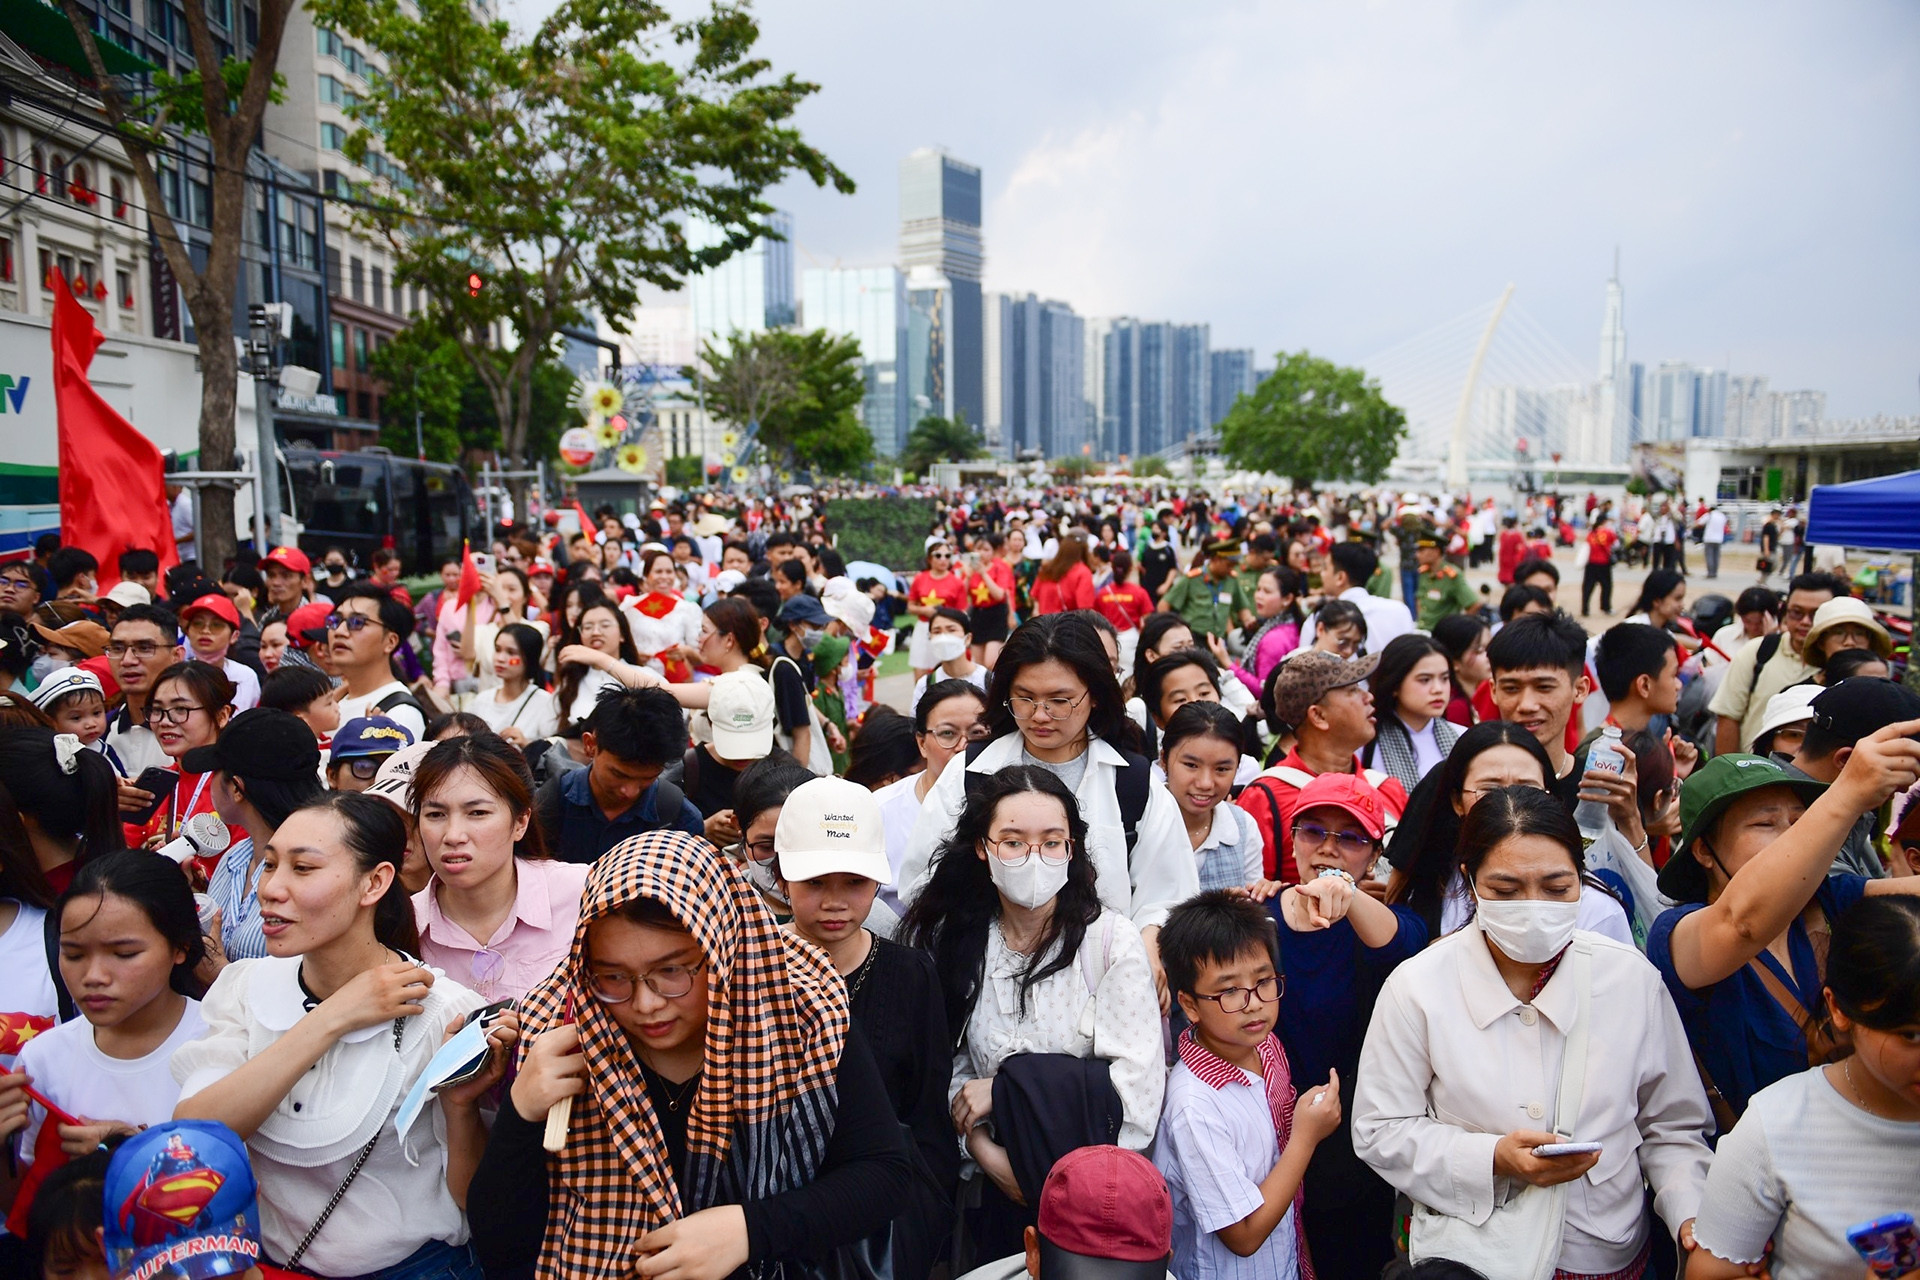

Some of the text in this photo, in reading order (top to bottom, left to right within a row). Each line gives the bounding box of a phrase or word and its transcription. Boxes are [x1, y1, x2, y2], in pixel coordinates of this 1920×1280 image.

[1594, 760, 1618, 771] laVie
[389, 767, 412, 776] adidas
[824, 812, 854, 821] Wanted
[826, 829, 851, 839] More
